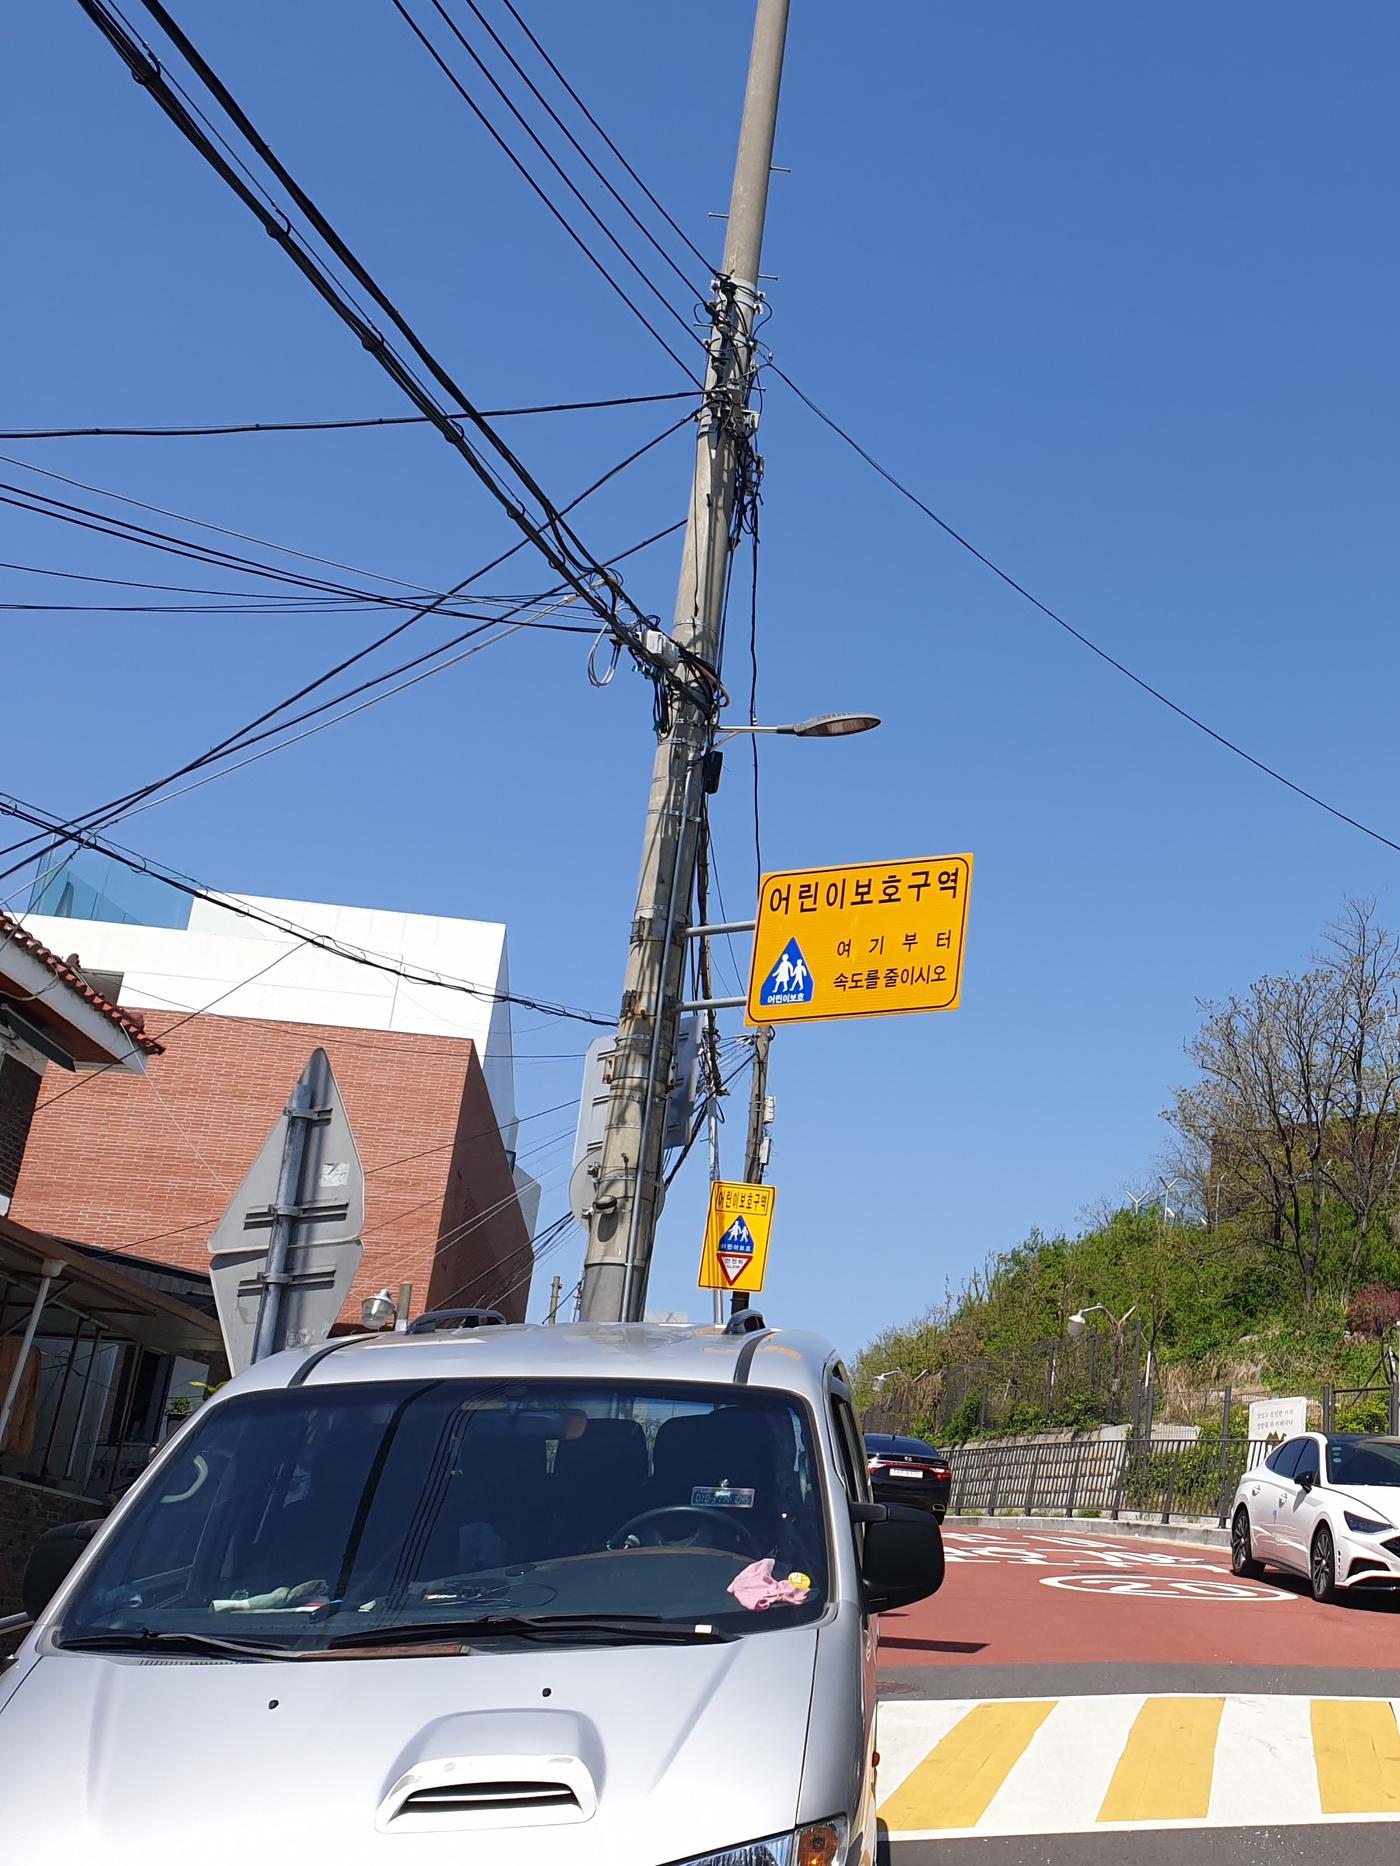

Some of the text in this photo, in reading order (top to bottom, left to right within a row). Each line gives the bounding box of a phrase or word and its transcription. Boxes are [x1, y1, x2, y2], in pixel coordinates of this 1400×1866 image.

[769, 867, 960, 915] 어린이보호구역
[767, 992, 805, 1004] 어린이보호
[718, 1190, 768, 1212] 어린이보호구역
[720, 1242, 752, 1252] 어린이보호
[1081, 1579, 1258, 1597] 20
